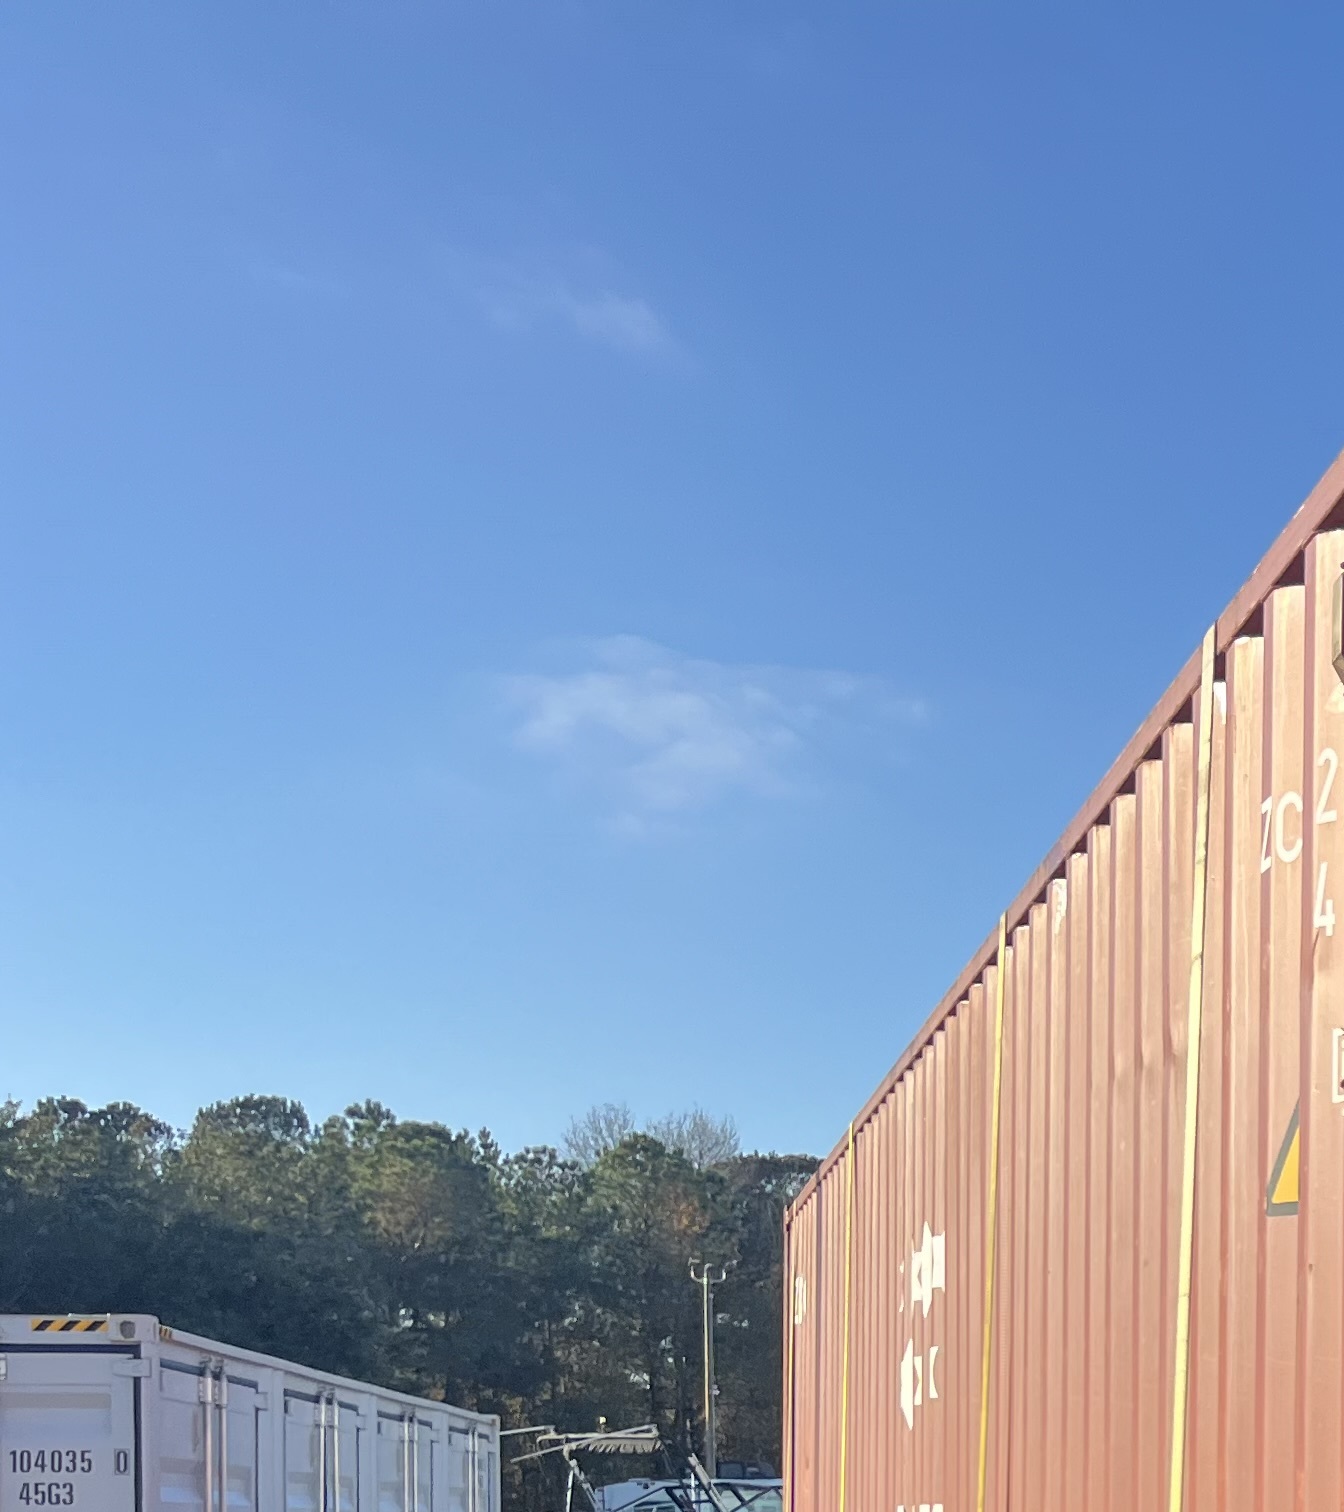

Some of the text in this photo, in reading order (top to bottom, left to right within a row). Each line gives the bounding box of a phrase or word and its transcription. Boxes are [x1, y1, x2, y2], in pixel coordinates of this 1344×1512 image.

[9, 1449, 129, 1474] 104035 0
[19, 1481, 75, 1506] 45G3
